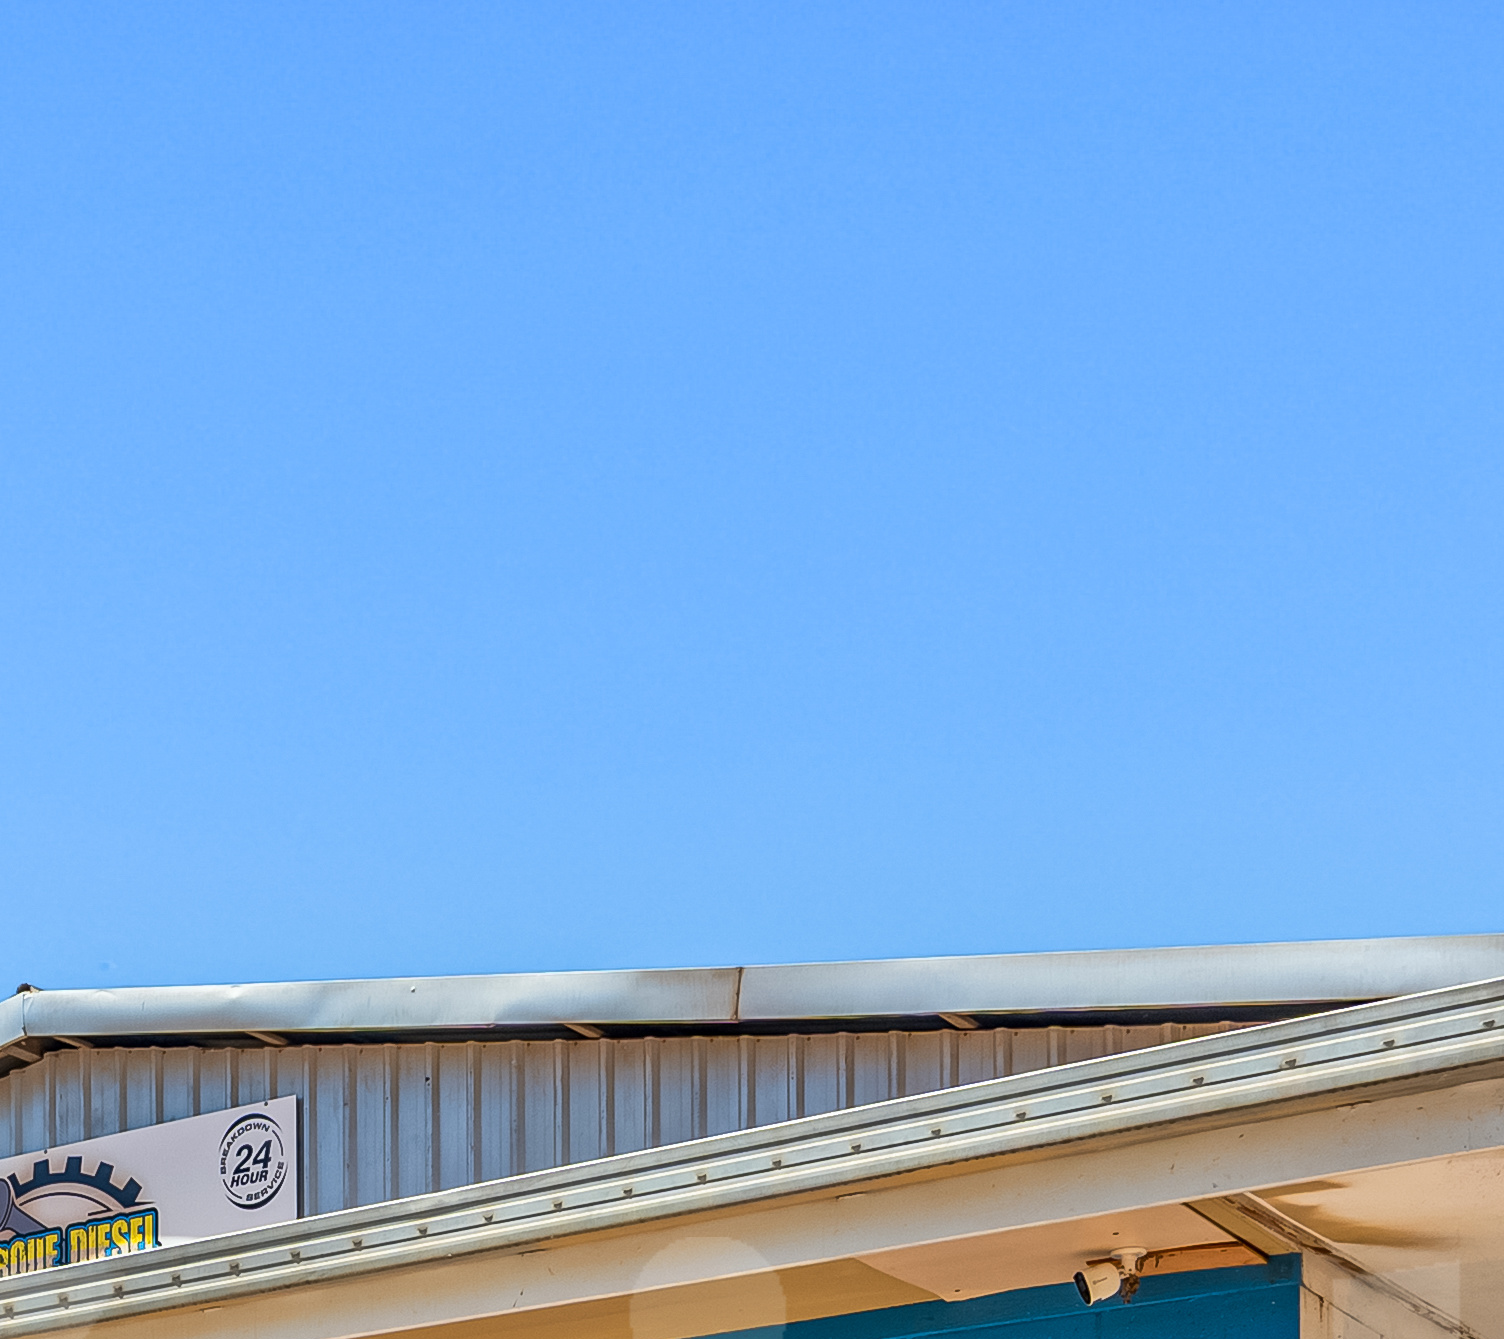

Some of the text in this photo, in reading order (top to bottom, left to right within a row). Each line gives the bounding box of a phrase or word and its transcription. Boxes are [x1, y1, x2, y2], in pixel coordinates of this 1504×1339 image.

[219, 1122, 270, 1174] BREAKDOWN
[232, 1139, 272, 1175] 24
[229, 1169, 268, 1188] HOUR
[245, 1161, 284, 1202] SERVICE
